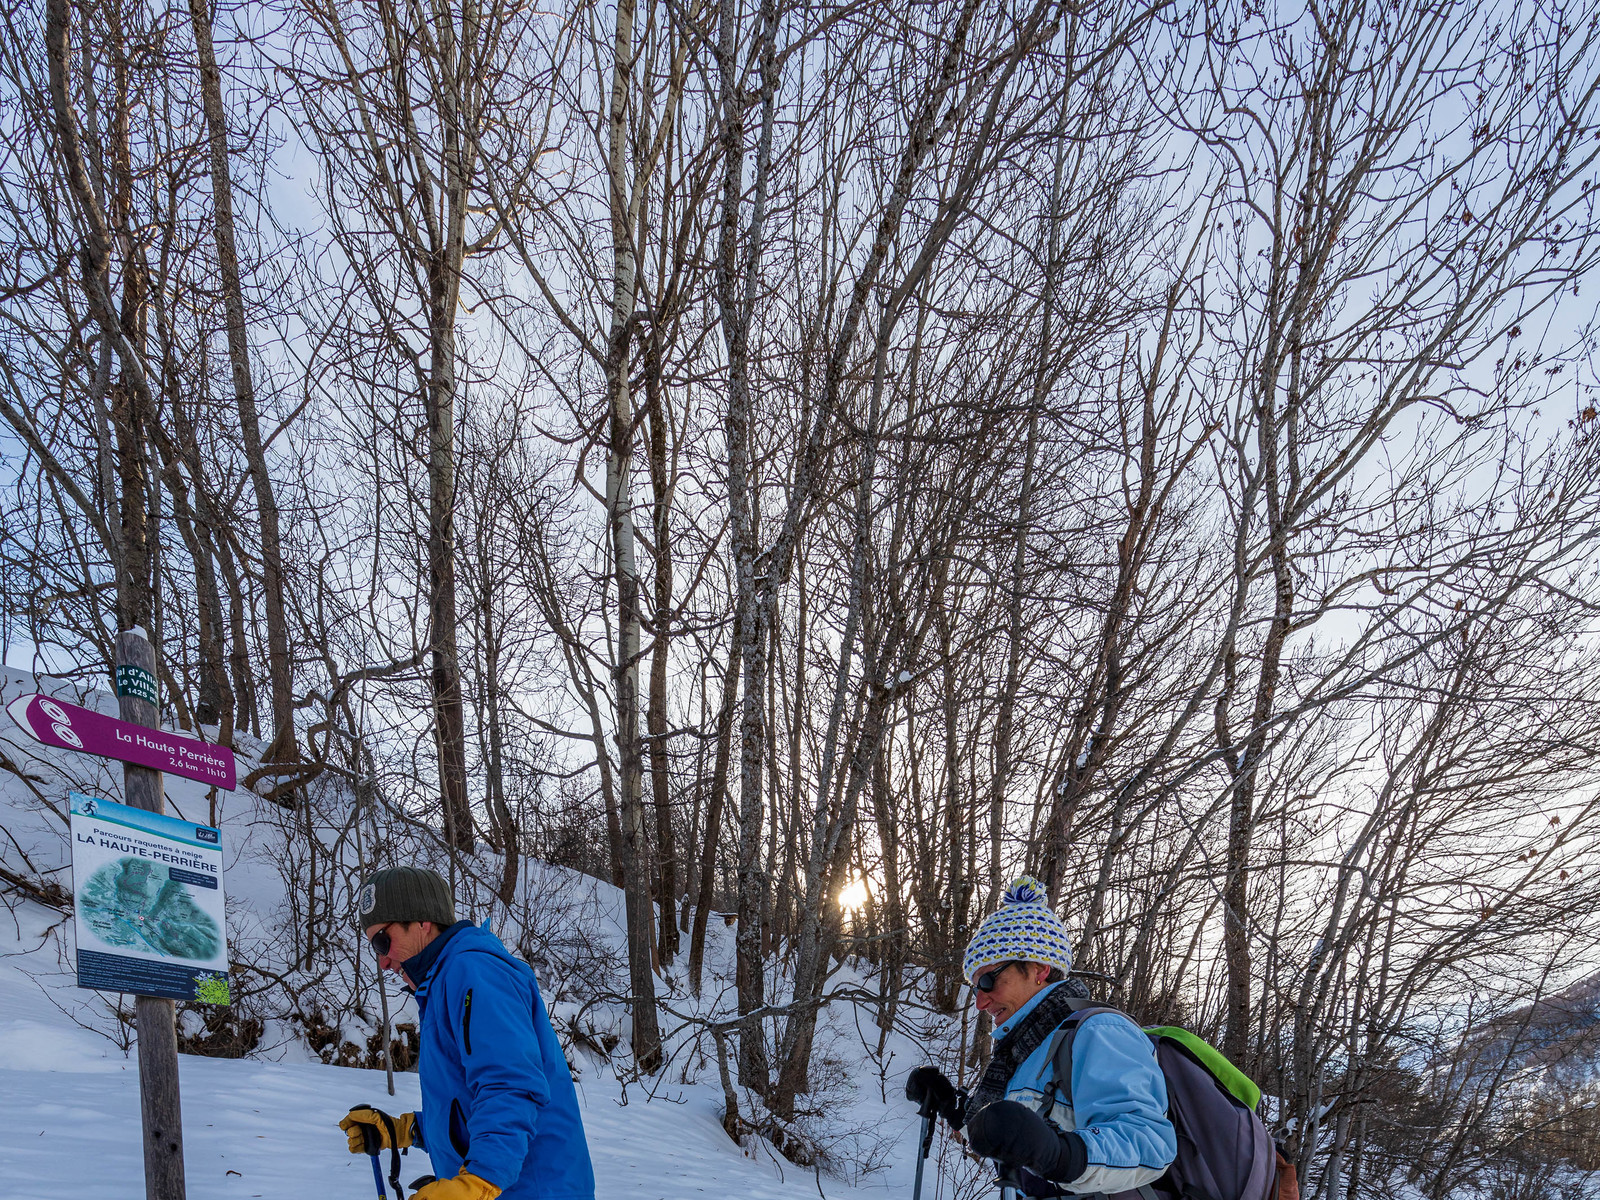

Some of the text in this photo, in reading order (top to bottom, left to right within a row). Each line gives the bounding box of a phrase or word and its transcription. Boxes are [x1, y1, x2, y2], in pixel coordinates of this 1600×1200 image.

[128, 669, 157, 687] d'Allo
[128, 688, 147, 698] 1425
[116, 729, 226, 768] La Haute Perrière
[169, 757, 184, 769] 2,6
[185, 762, 199, 773] km
[207, 768, 227, 779] 1h10
[77, 833, 217, 873] LA HAUTE-PERRIÈRE
[93, 828, 132, 843] Parcours
[134, 839, 173, 853] raquettes
[181, 850, 203, 860] neige
